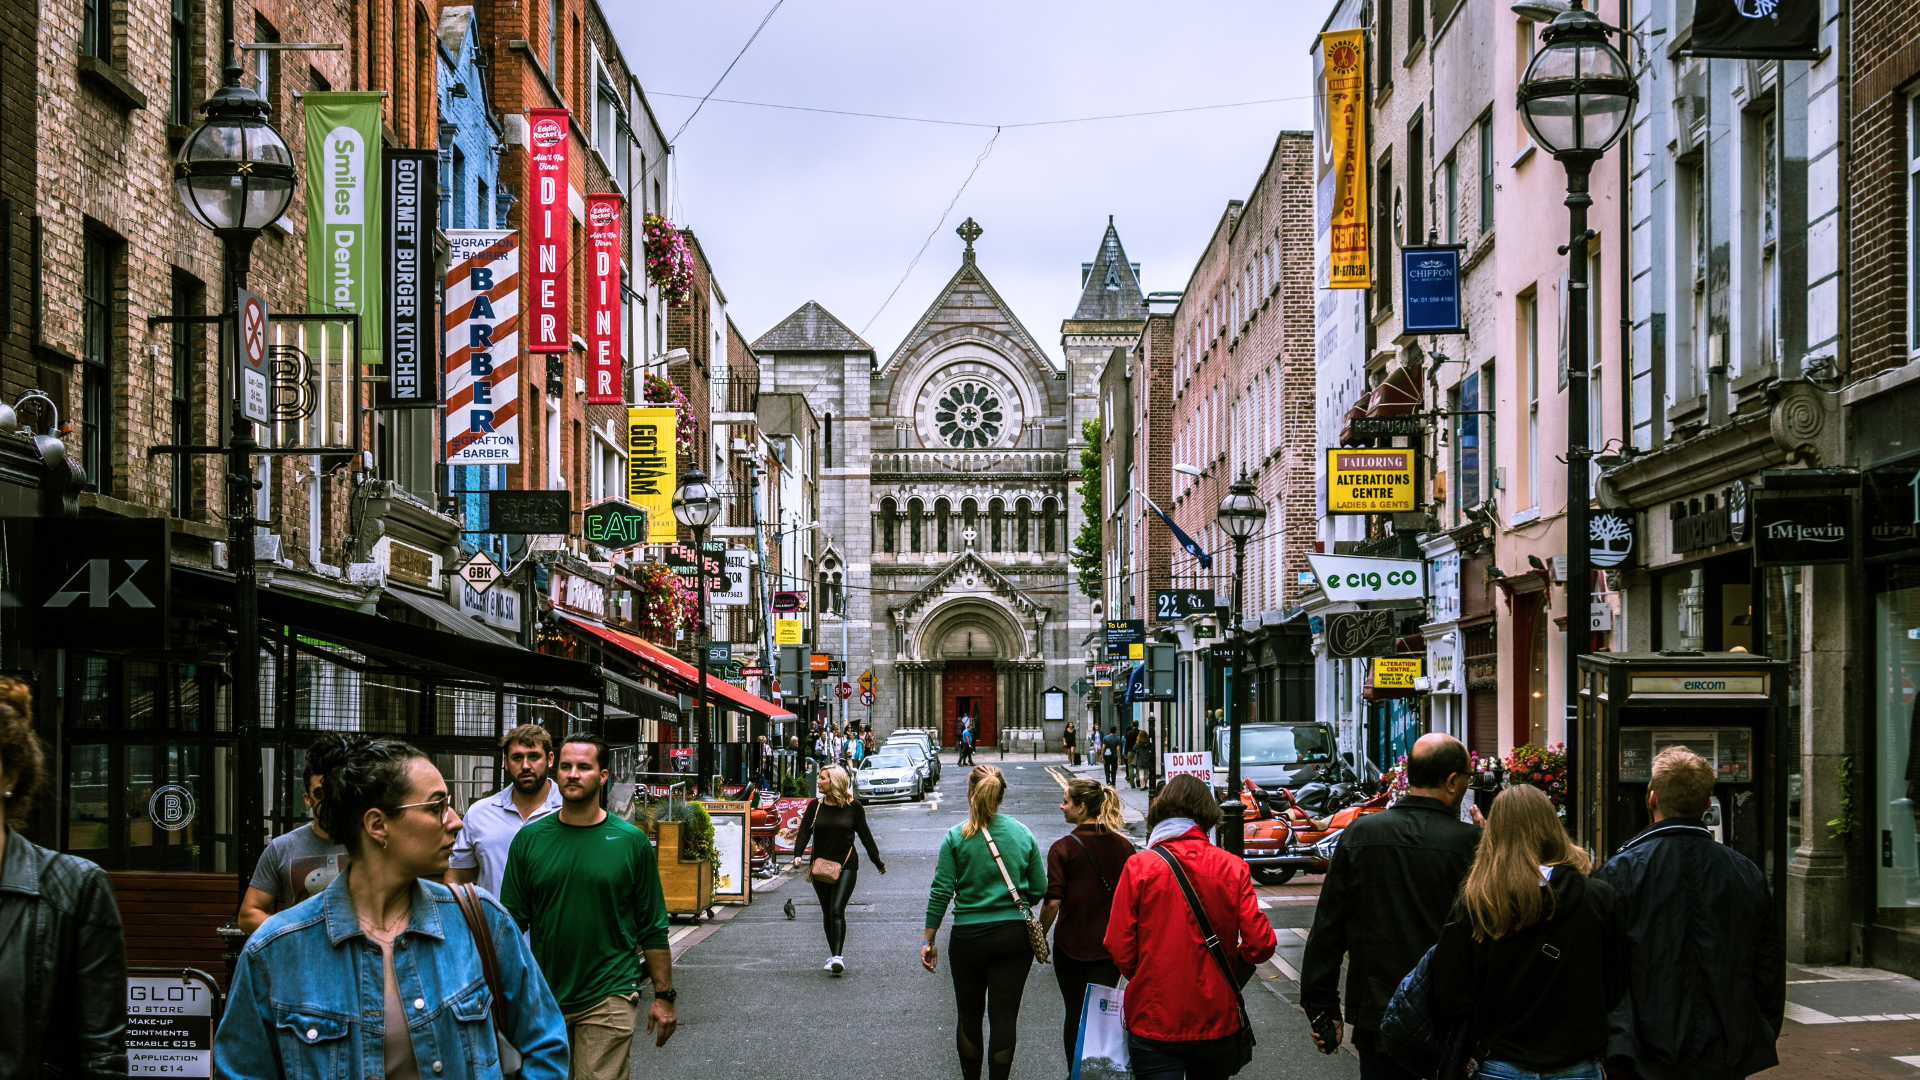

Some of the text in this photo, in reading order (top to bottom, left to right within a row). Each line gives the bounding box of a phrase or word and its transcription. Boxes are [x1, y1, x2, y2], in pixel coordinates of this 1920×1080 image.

[1343, 103, 1355, 219] ALTERATION
[334, 139, 356, 308] Smiles Dental
[461, 238, 513, 247] GRAFTON
[1333, 227, 1365, 249] CENTRE
[463, 251, 508, 260] BARBER
[540, 176, 556, 342] DINER
[397, 159, 416, 399] GOURMET BURGER KITCHEN
[1409, 269, 1453, 278] CHIFFON
[597, 252, 611, 395] DINER
[469, 267, 496, 433] BARBER
[461, 436, 513, 445] GRAFTON
[463, 449, 509, 458] BARBER
[630, 424, 674, 496] GOTHAM
[1343, 456, 1403, 468] TAILORING
[1337, 473, 1410, 485] ALTERATIONS
[1352, 487, 1394, 498] CENTRE
[497, 498, 563, 510] GRAFTON
[1336, 501, 1368, 509] LADIES
[1379, 500, 1410, 508] GENTS
[501, 513, 559, 525] BARBER
[588, 511, 642, 541] EAT
[726, 556, 745, 568] METIC
[469, 567, 492, 579] GBK
[43, 559, 156, 608] AK
[1327, 574, 1341, 589] e
[1346, 571, 1382, 592] cig
[1387, 570, 1417, 586] co
[1157, 594, 1182, 617] 22
[709, 650, 729, 658] SO
[835, 685, 852, 694] SOP
[1173, 754, 1203, 767] DO NOT
[1191, 769, 1211, 781] THIS
[165, 794, 183, 822] B
[130, 986, 202, 1002] GLOT
[126, 1029, 189, 1037] POINTMENTS
